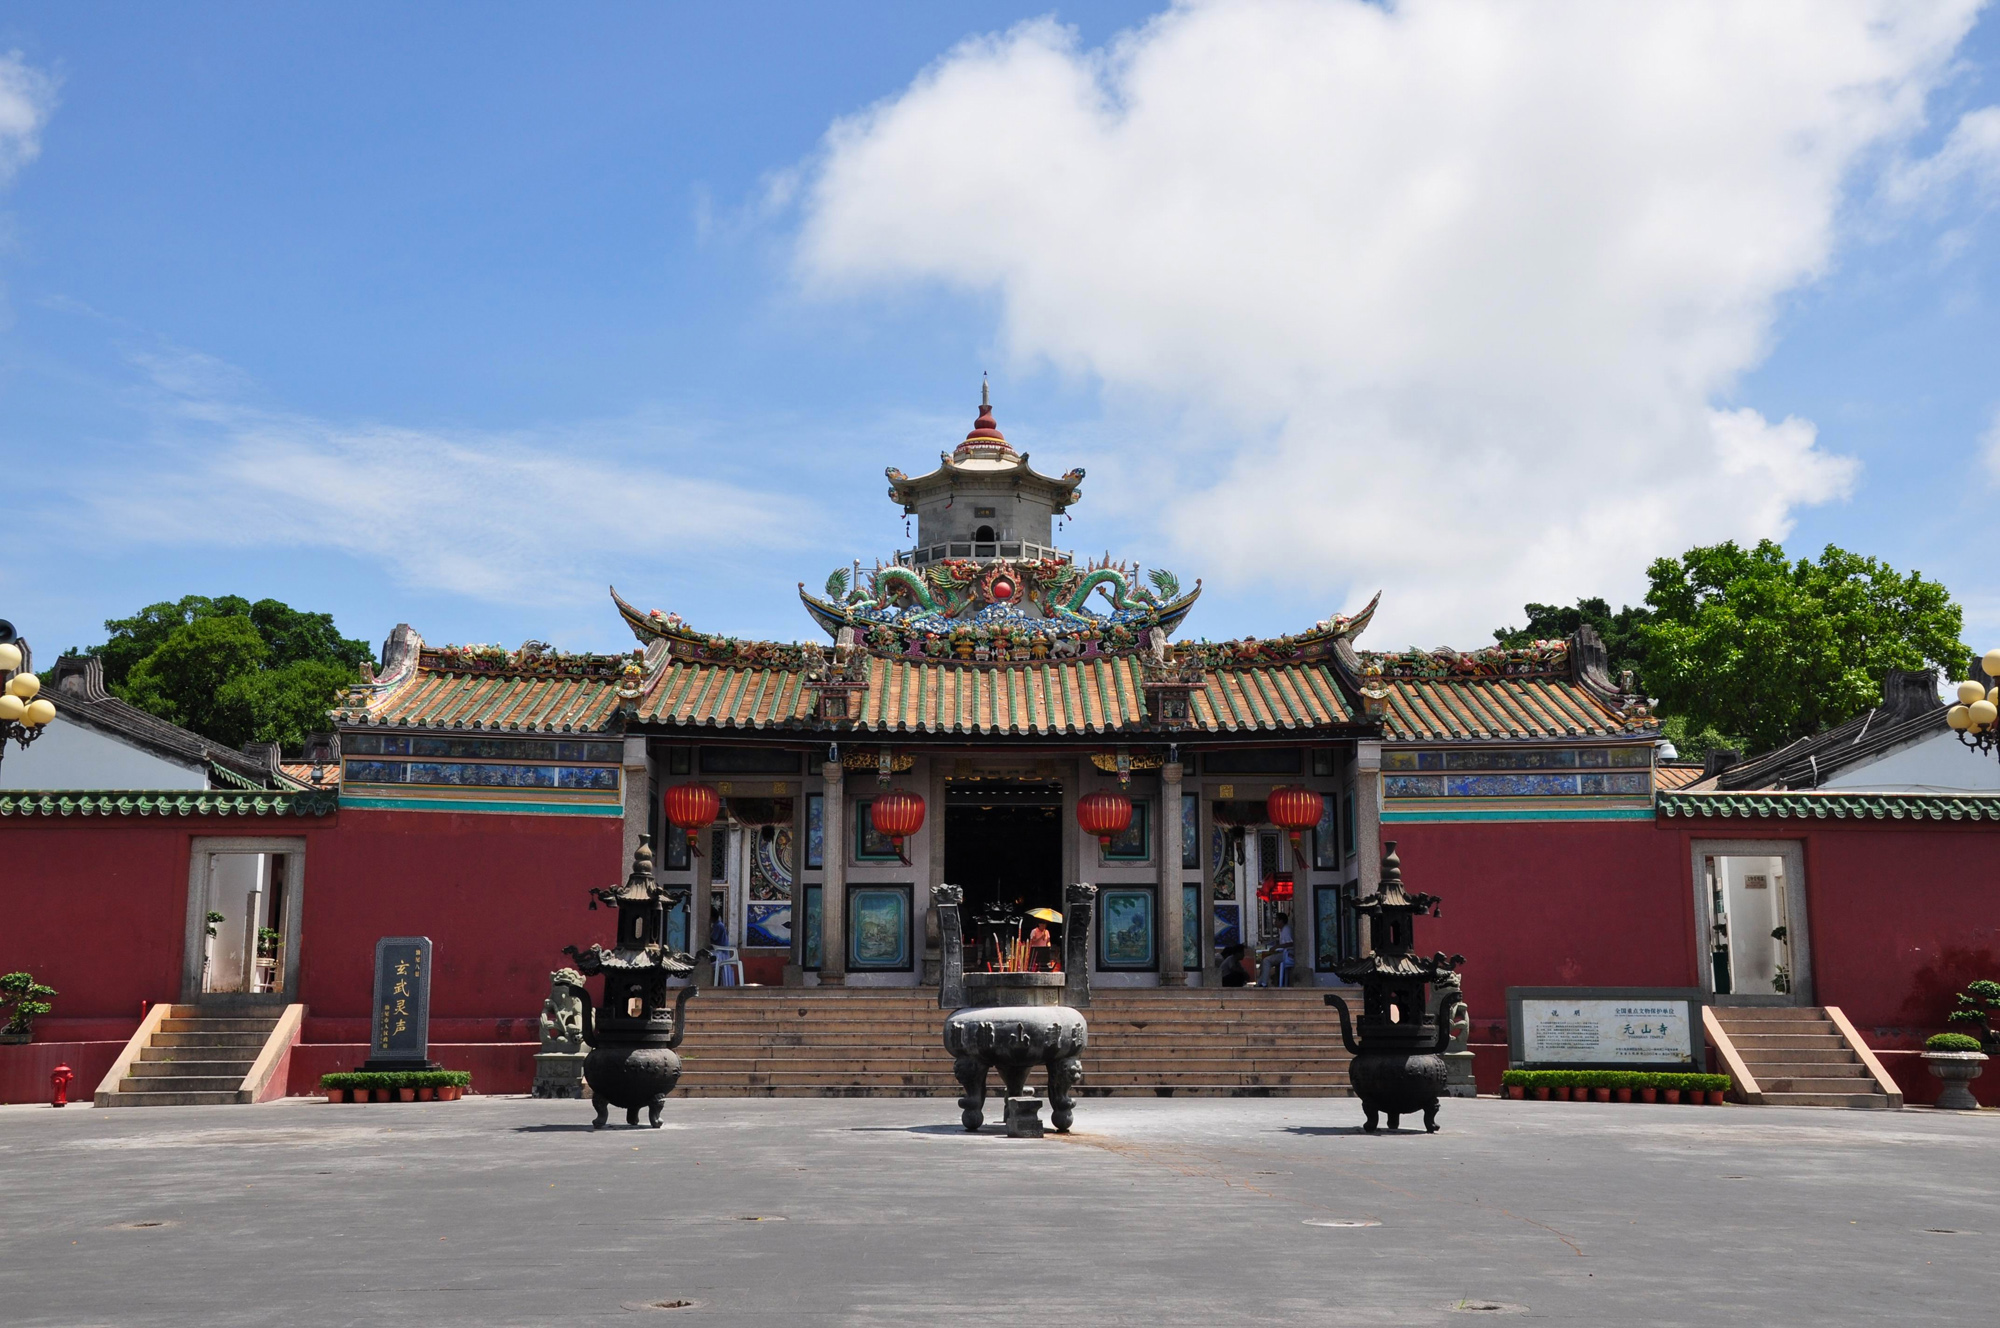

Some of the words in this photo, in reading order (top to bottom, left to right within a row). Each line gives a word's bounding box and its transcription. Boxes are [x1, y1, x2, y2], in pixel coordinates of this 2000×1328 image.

[392, 959, 410, 1036] 玄武灵声
[1623, 1022, 1668, 1035] 元山寺
